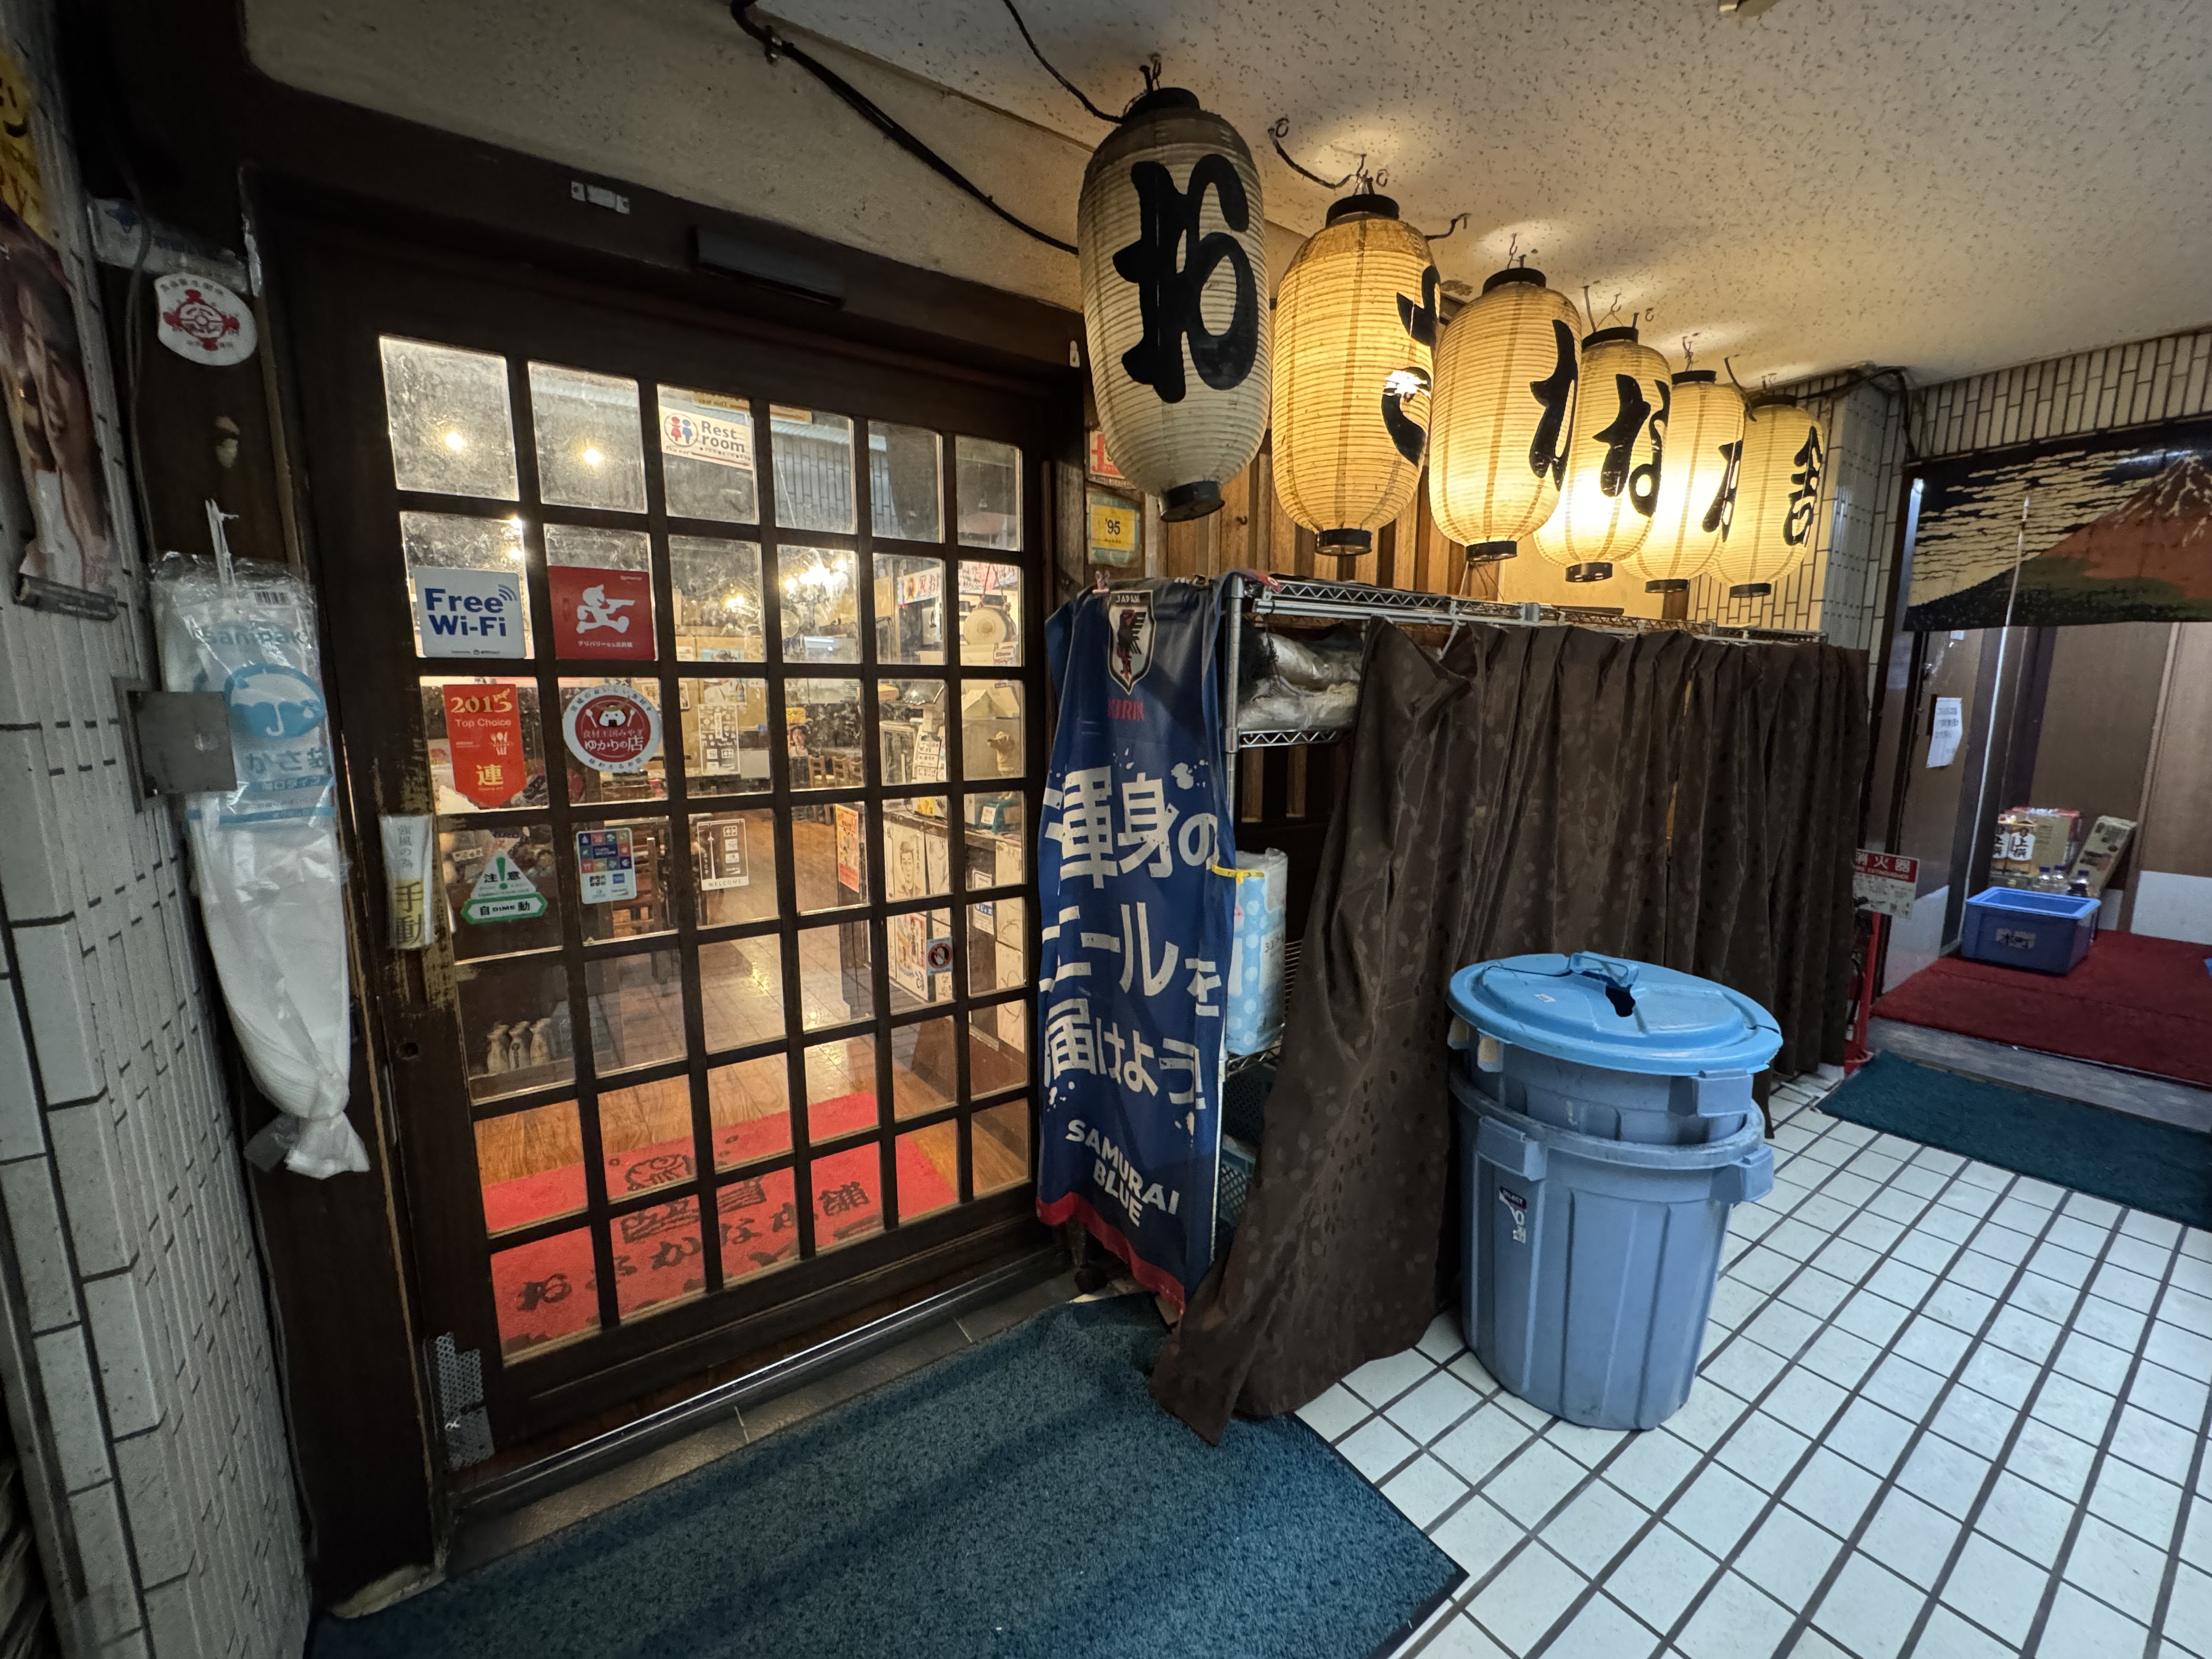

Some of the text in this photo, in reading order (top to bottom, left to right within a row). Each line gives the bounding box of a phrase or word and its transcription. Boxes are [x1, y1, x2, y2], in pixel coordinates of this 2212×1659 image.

[701, 420, 738, 440] Rest
[702, 435, 745, 453] room
[425, 588, 504, 613] Free
[1115, 594, 1141, 603] JAPAN
[428, 614, 506, 636] Wi-Fi
[450, 688, 514, 713] 2015
[1108, 698, 1145, 721] KIRIN
[455, 718, 511, 729] Top Choice
[585, 735, 644, 752] ゆかりの店
[1044, 765, 1220, 889] 渾身の
[708, 878, 742, 887] WELCOME
[395, 880, 423, 946] 手動
[480, 905, 490, 916] 自
[517, 901, 531, 912] 動
[1044, 998, 1206, 1110] 届けよう
[1065, 1119, 1180, 1216] SAMURAI
[1092, 1158, 1143, 1227] BLUE
